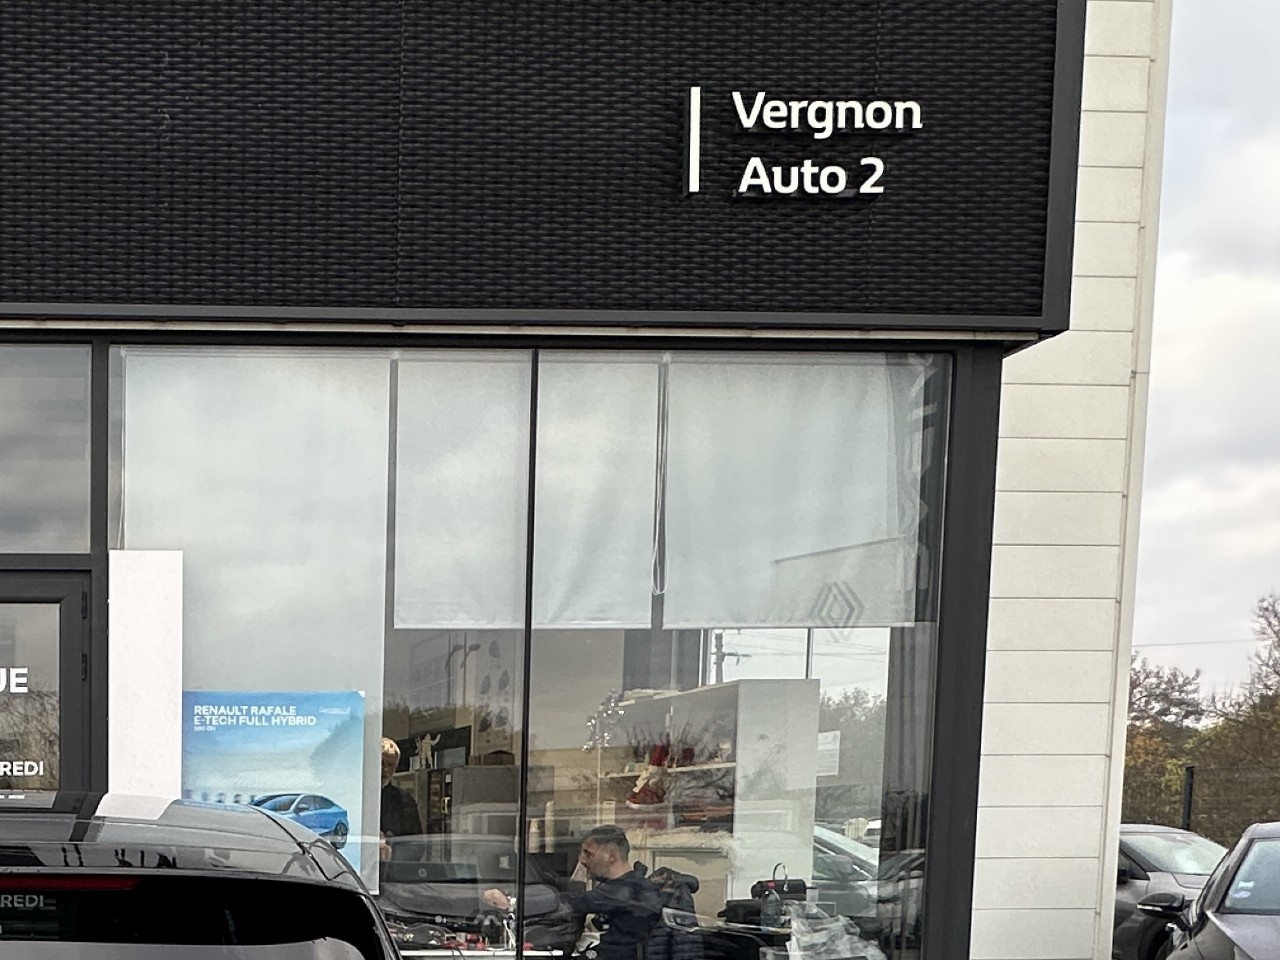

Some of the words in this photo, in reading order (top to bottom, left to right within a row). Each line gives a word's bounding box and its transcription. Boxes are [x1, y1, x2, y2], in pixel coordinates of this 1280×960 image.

[731, 91, 923, 139] Vergnon
[738, 156, 847, 194] Auto
[859, 157, 885, 194] 2
[194, 705, 248, 715] RENAULT
[250, 706, 297, 715] RAFALE
[194, 715, 236, 726] E-TECH
[239, 715, 268, 726] FULL
[271, 715, 317, 726] HYBRID
